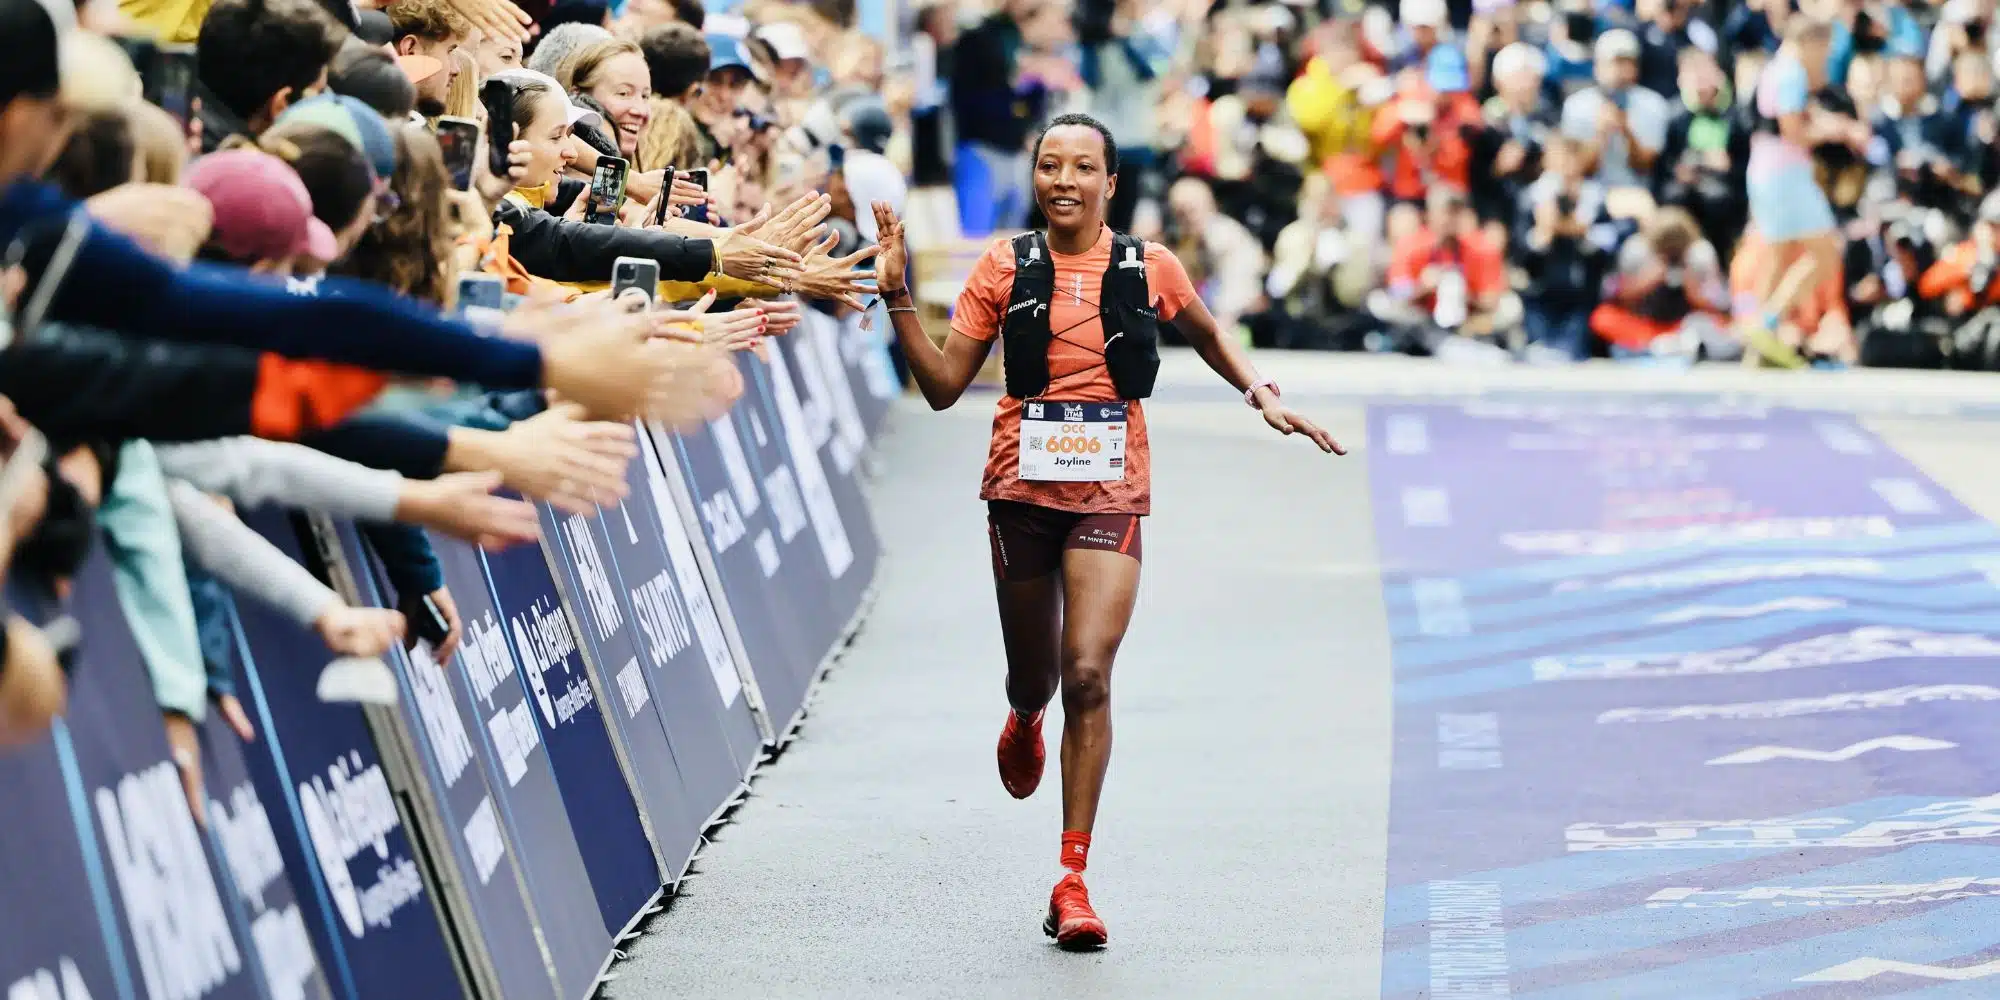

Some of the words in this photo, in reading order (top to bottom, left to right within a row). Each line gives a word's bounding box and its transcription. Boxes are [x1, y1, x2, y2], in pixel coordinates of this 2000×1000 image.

[1062, 424, 1086, 434] OCC
[1045, 436, 1101, 454] 6006
[1054, 457, 1091, 468] Joyline
[631, 568, 692, 669] SUUNTO
